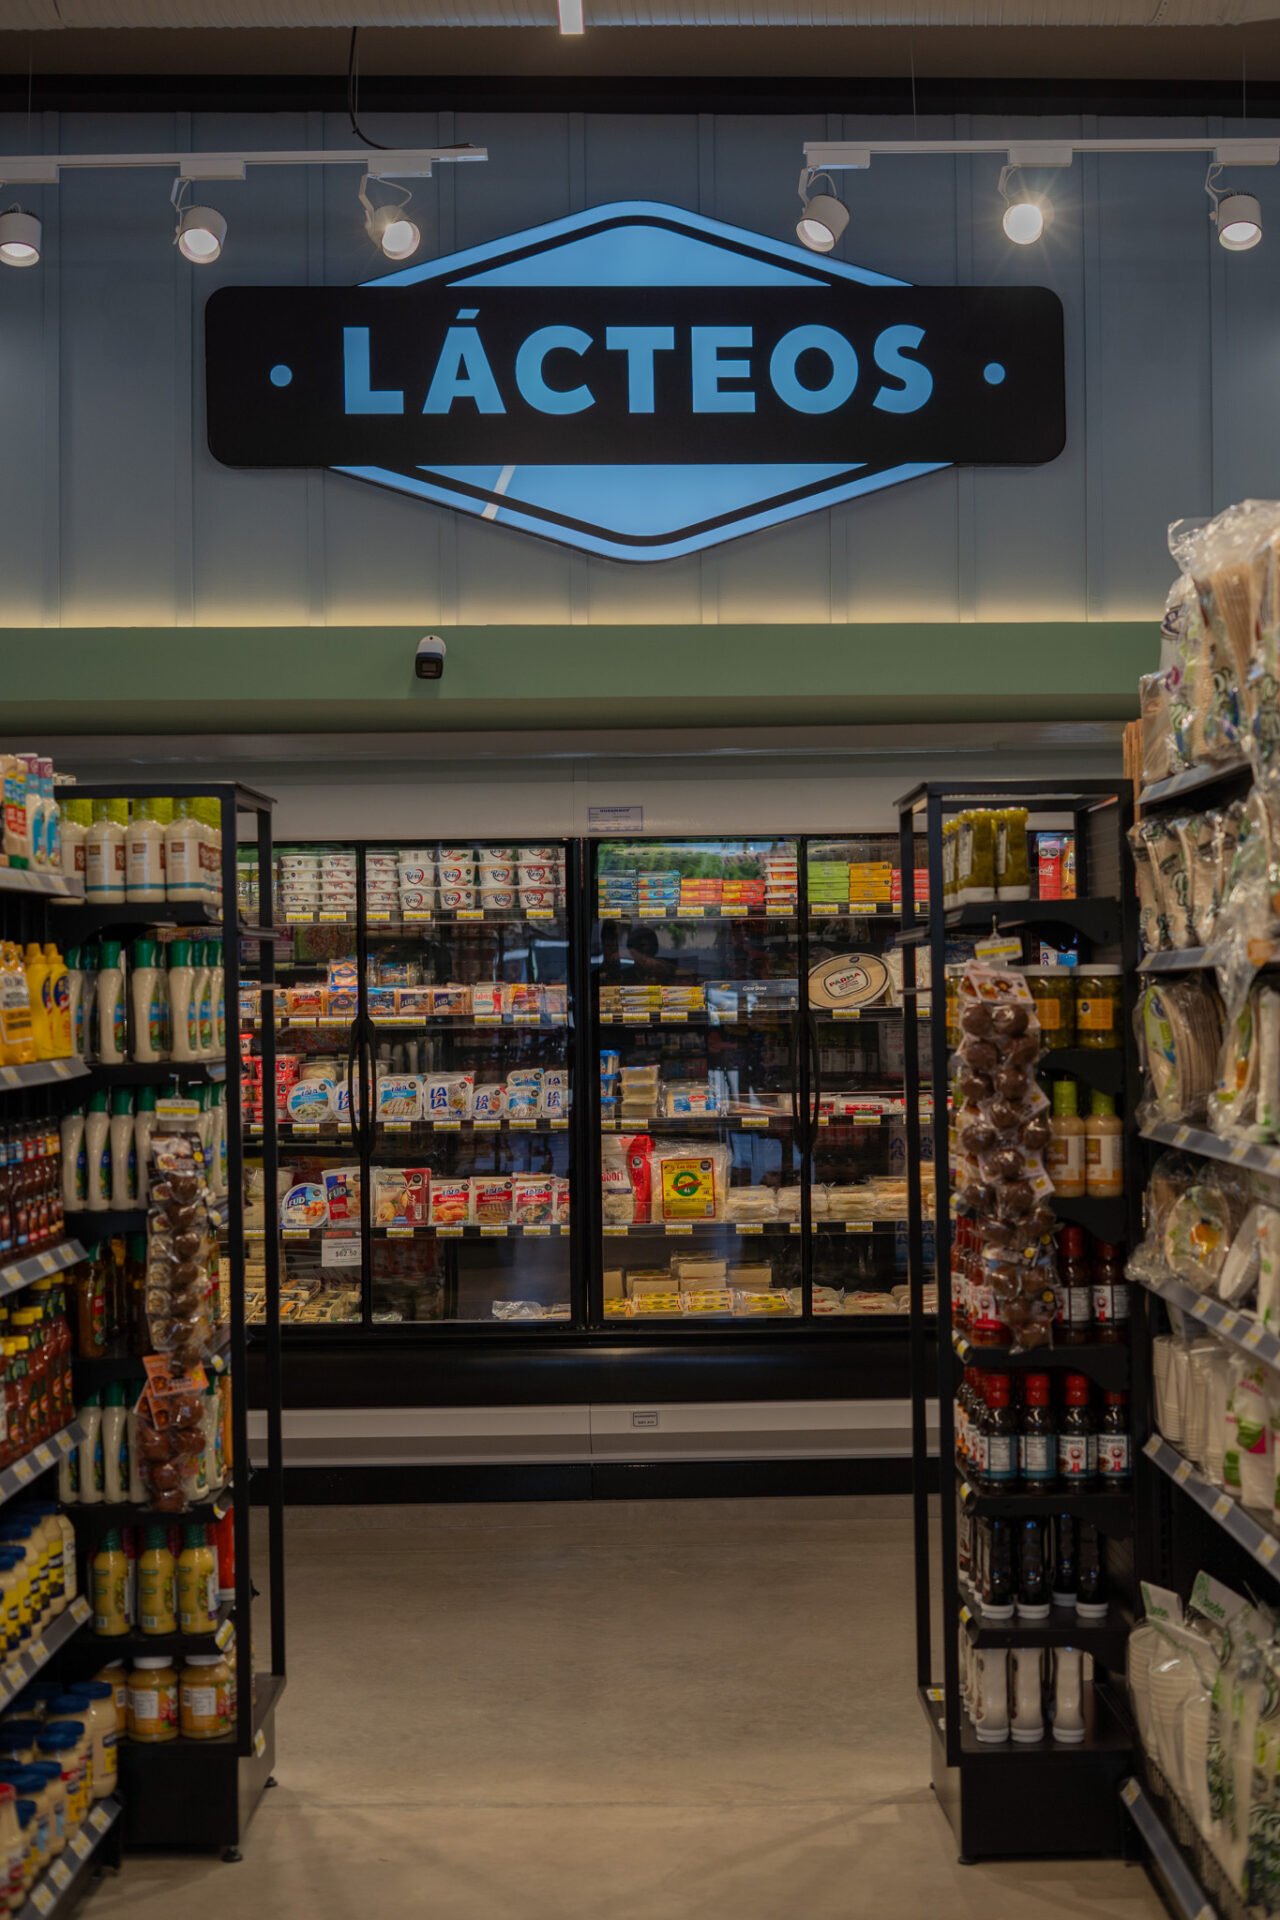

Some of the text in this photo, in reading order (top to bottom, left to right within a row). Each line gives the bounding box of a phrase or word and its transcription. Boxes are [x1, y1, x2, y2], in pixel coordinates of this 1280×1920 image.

[342, 308, 934, 416] LÁCTEOS
[828, 971, 861, 988] PARMA
[327, 1186, 347, 1201] FUD
[286, 1196, 306, 1208] FUD
